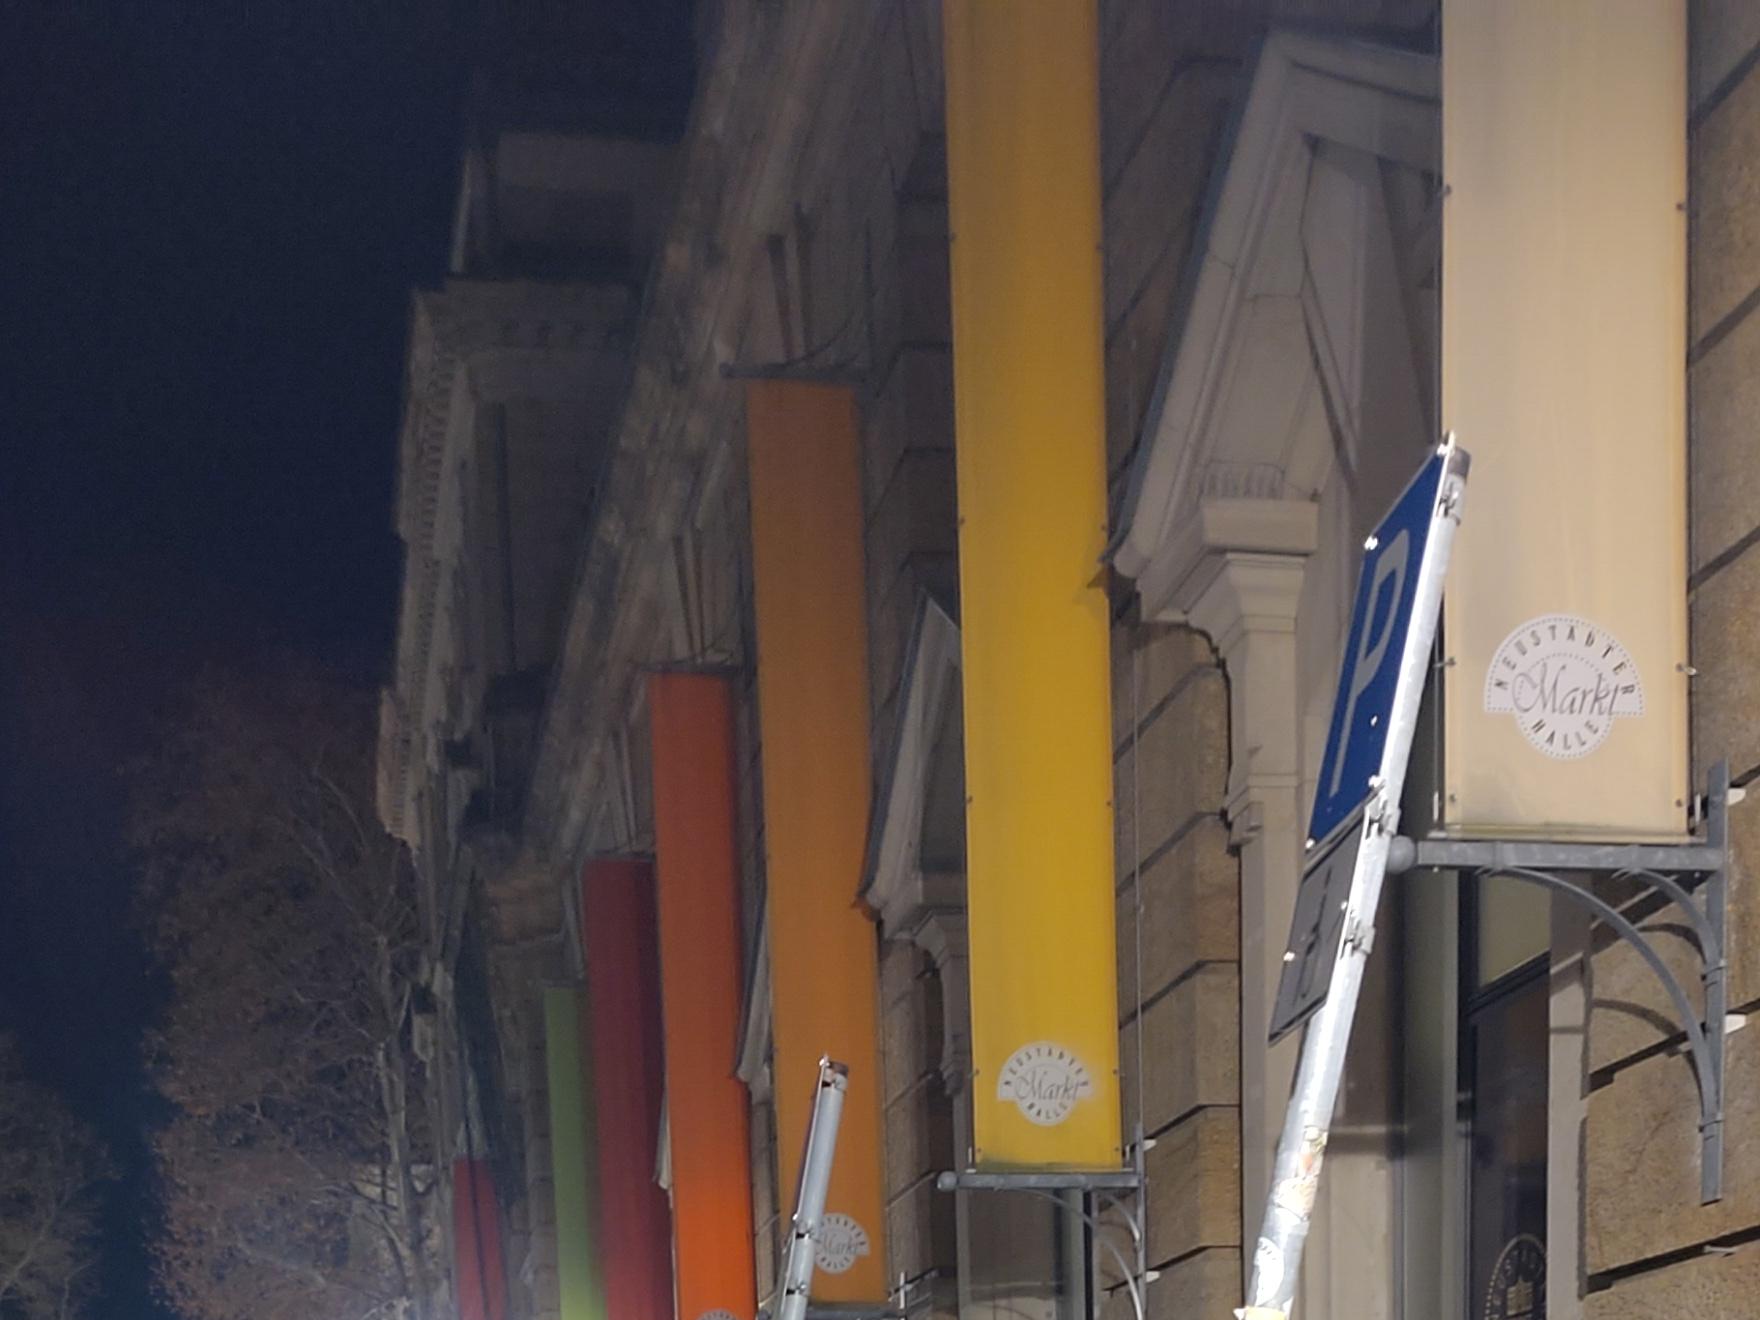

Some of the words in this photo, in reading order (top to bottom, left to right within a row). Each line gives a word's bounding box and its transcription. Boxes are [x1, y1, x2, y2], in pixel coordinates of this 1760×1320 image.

[1329, 528, 1410, 799] P
[1511, 661, 1620, 716] Markt
[1530, 718, 1599, 751] HALLE
[1014, 1067, 1080, 1102] Markt
